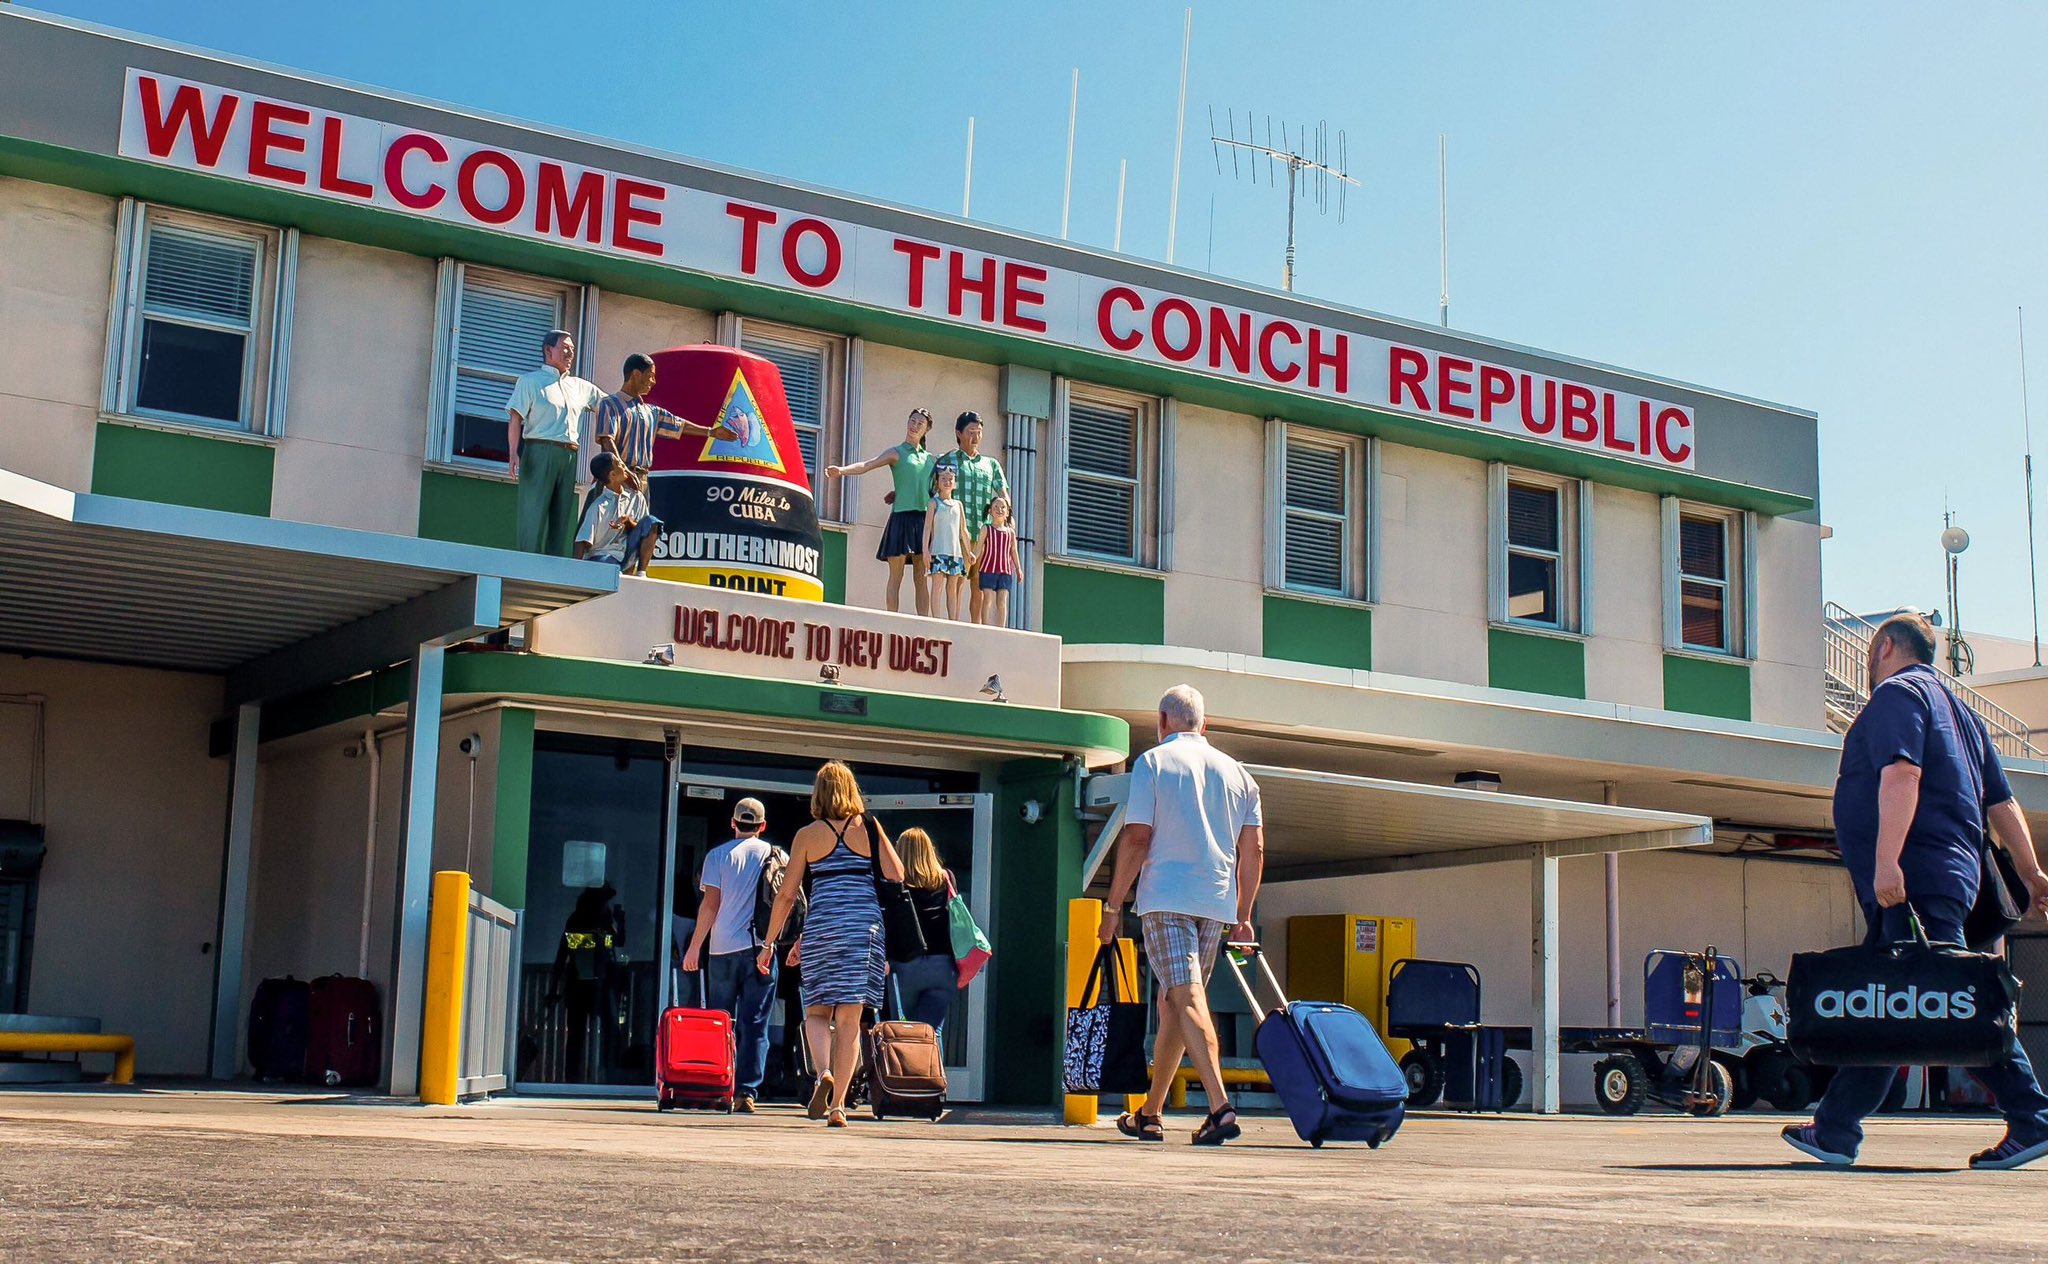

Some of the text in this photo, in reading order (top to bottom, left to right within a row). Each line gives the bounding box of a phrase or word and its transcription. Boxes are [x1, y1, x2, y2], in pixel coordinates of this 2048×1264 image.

[139, 76, 1691, 463] WELCOME TO THE CONCH REPUBLIC
[706, 486, 791, 511] 90 Miles to
[728, 503, 776, 522] CUBA
[654, 531, 820, 576] SOUTHERNMOST
[674, 605, 953, 677] WELCOME TO KEY WEST
[1814, 983, 1976, 1019] adidas
